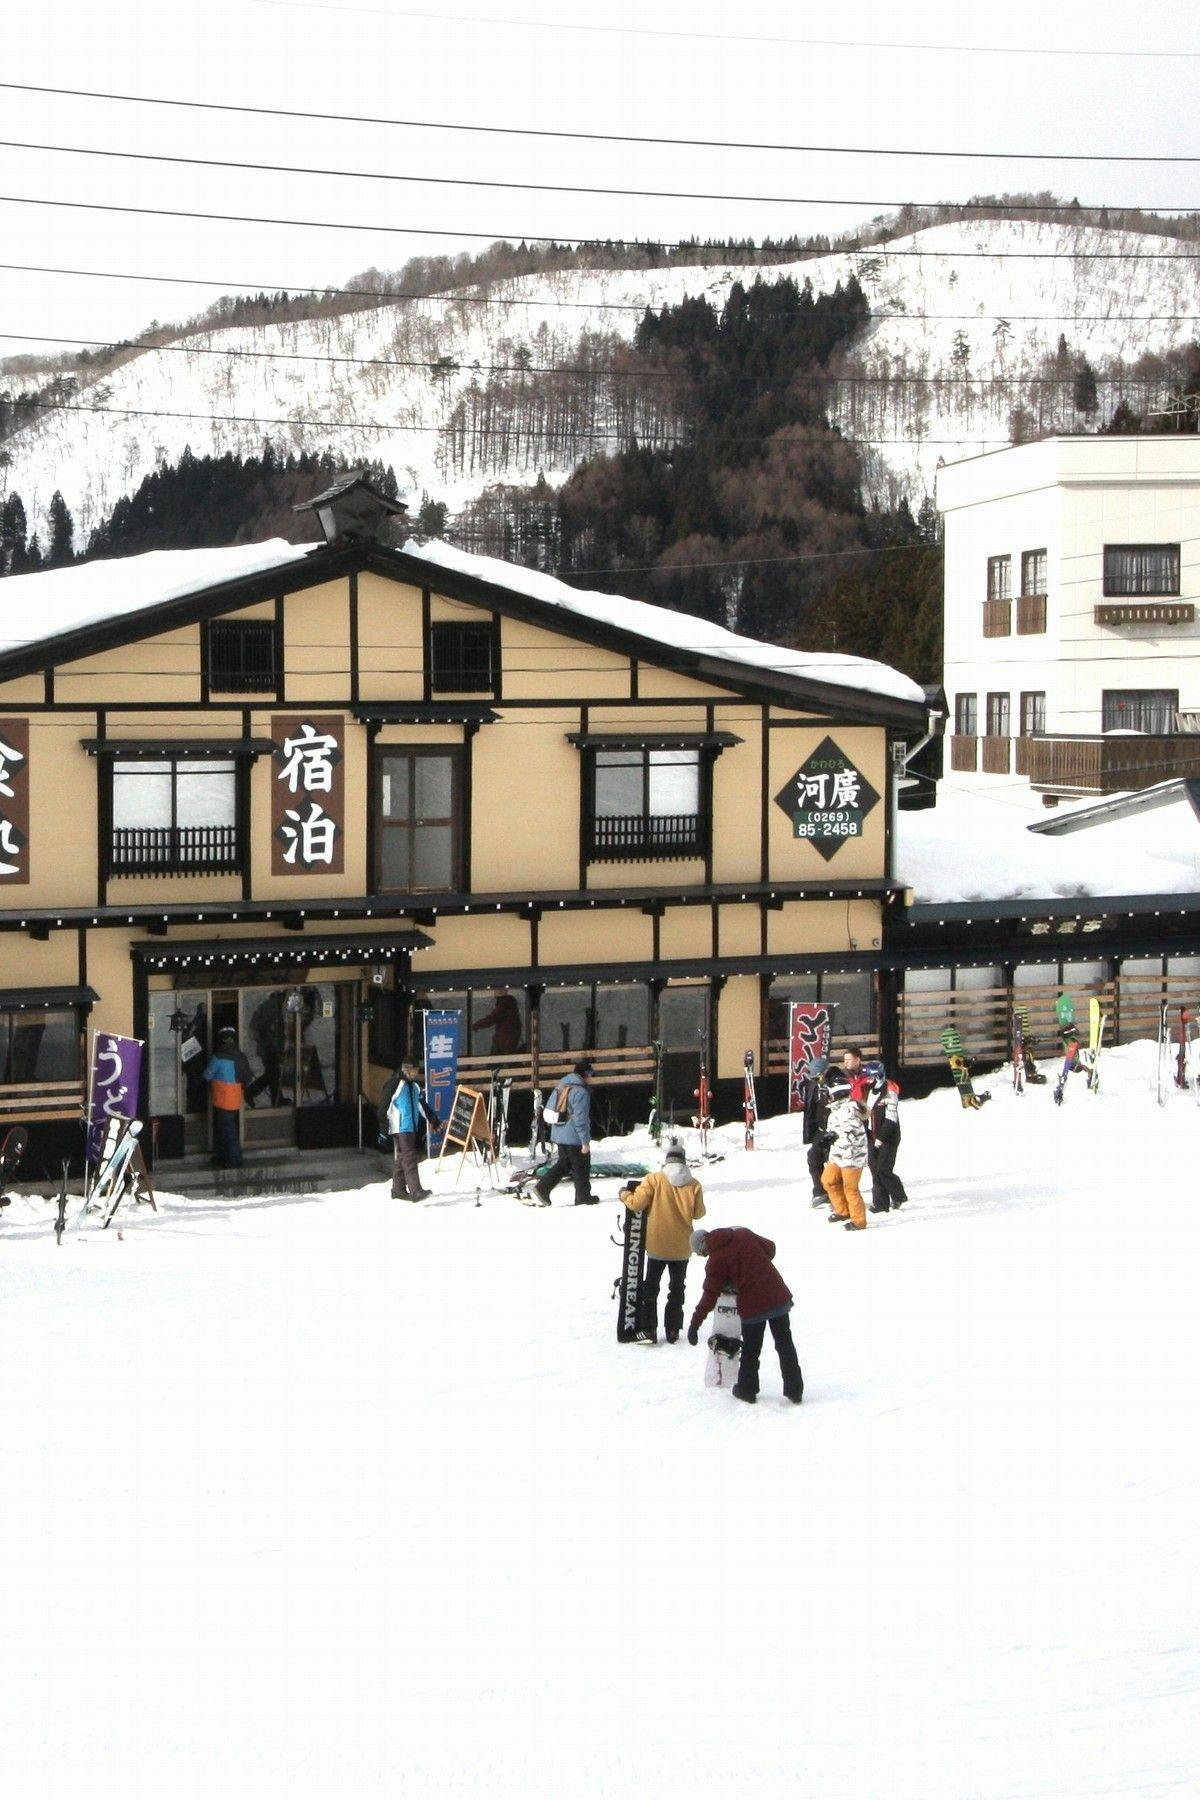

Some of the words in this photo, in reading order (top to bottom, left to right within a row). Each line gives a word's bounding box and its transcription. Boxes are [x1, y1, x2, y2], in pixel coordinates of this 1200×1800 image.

[278, 724, 338, 865] 宿泊
[797, 768, 861, 809] 河廣
[798, 822, 858, 836] 85-2458
[808, 812, 850, 822] (0269)
[624, 1209, 643, 1330] PRINGBREAK
